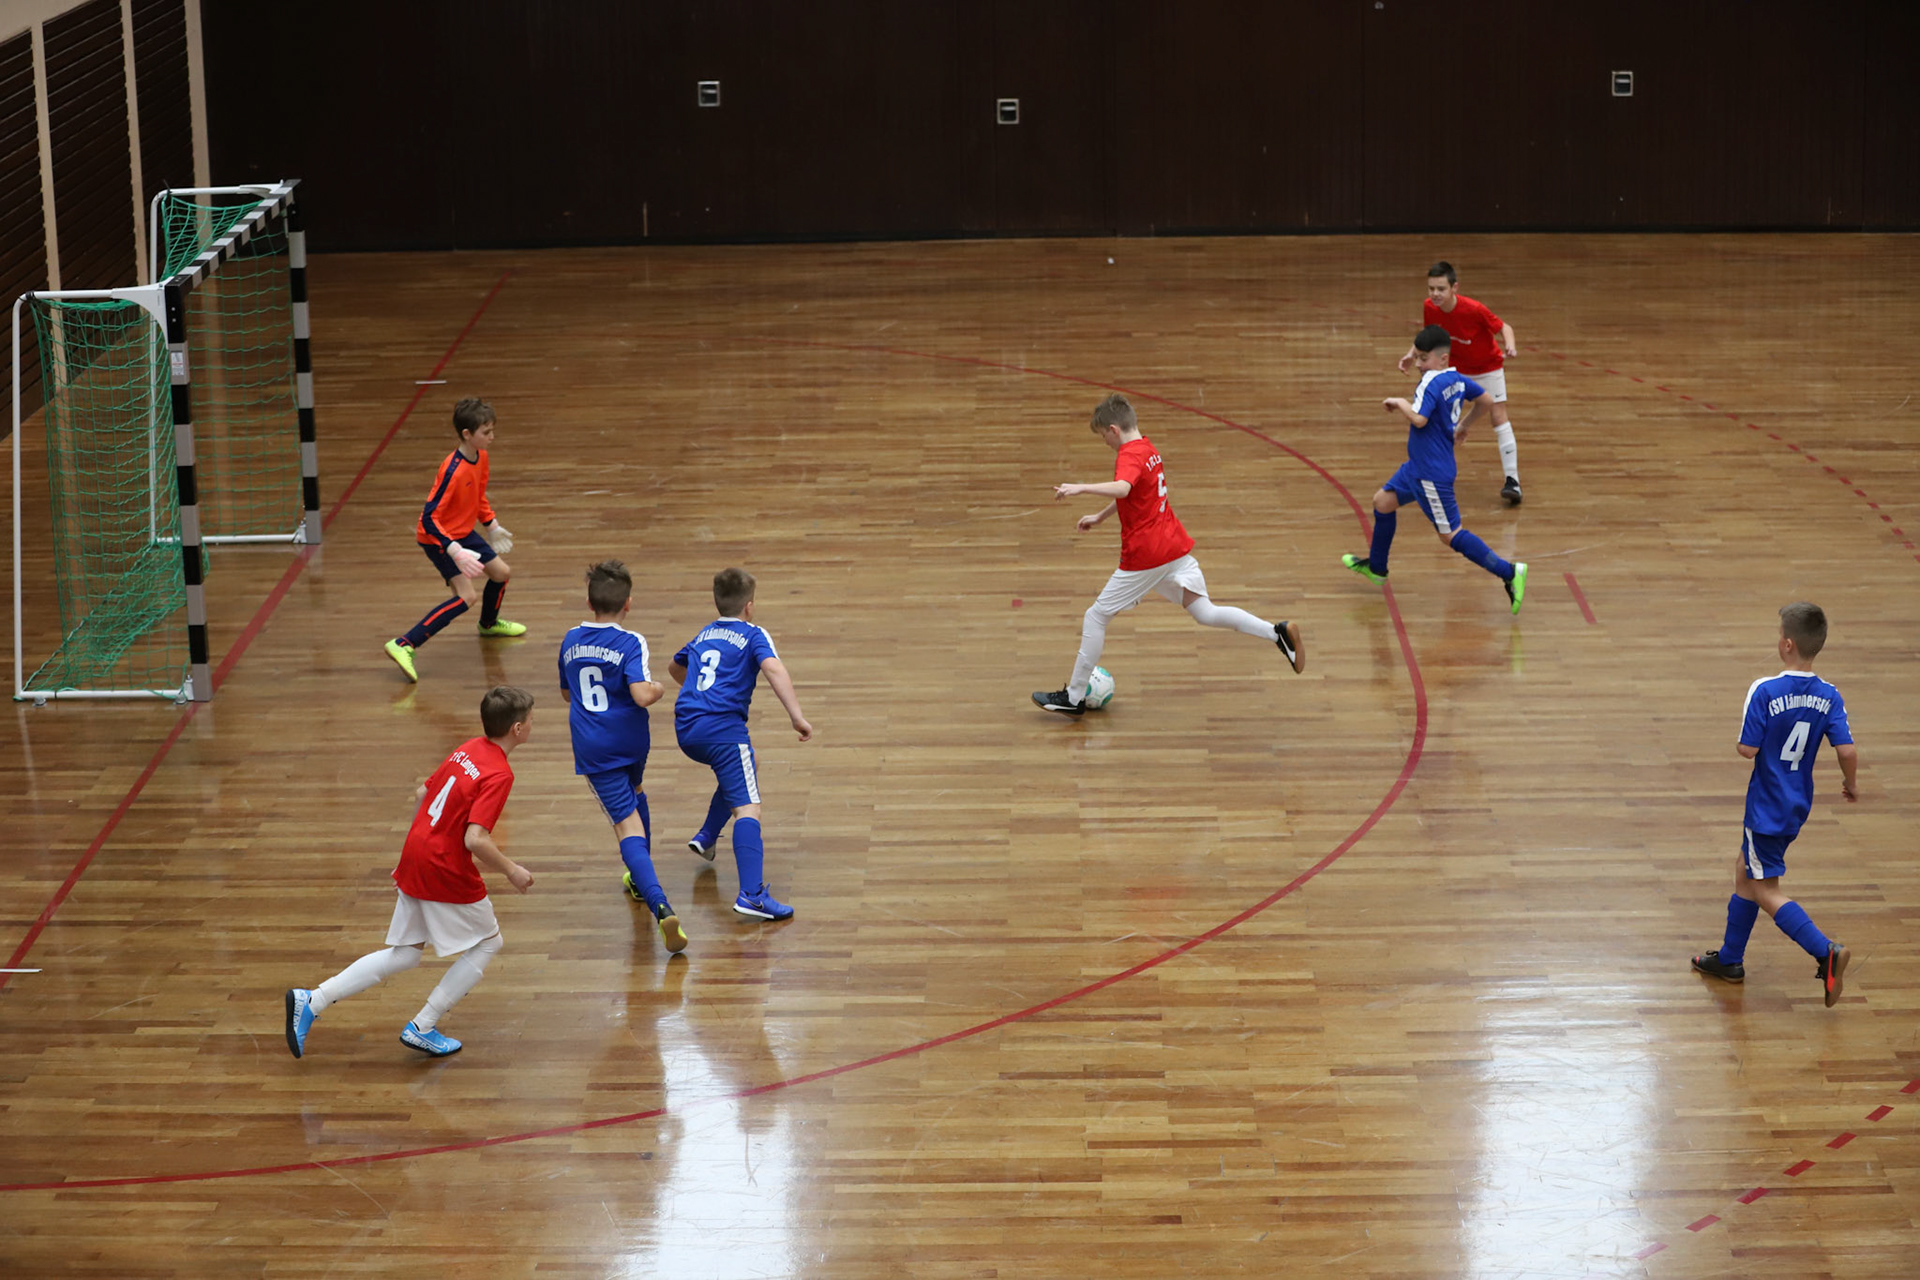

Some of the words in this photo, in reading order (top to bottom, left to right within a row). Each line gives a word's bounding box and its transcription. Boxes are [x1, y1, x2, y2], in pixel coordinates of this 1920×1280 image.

[578, 665, 609, 712] 6
[696, 649, 721, 692] 3
[1780, 720, 1811, 771] 4
[427, 775, 457, 827] 4
